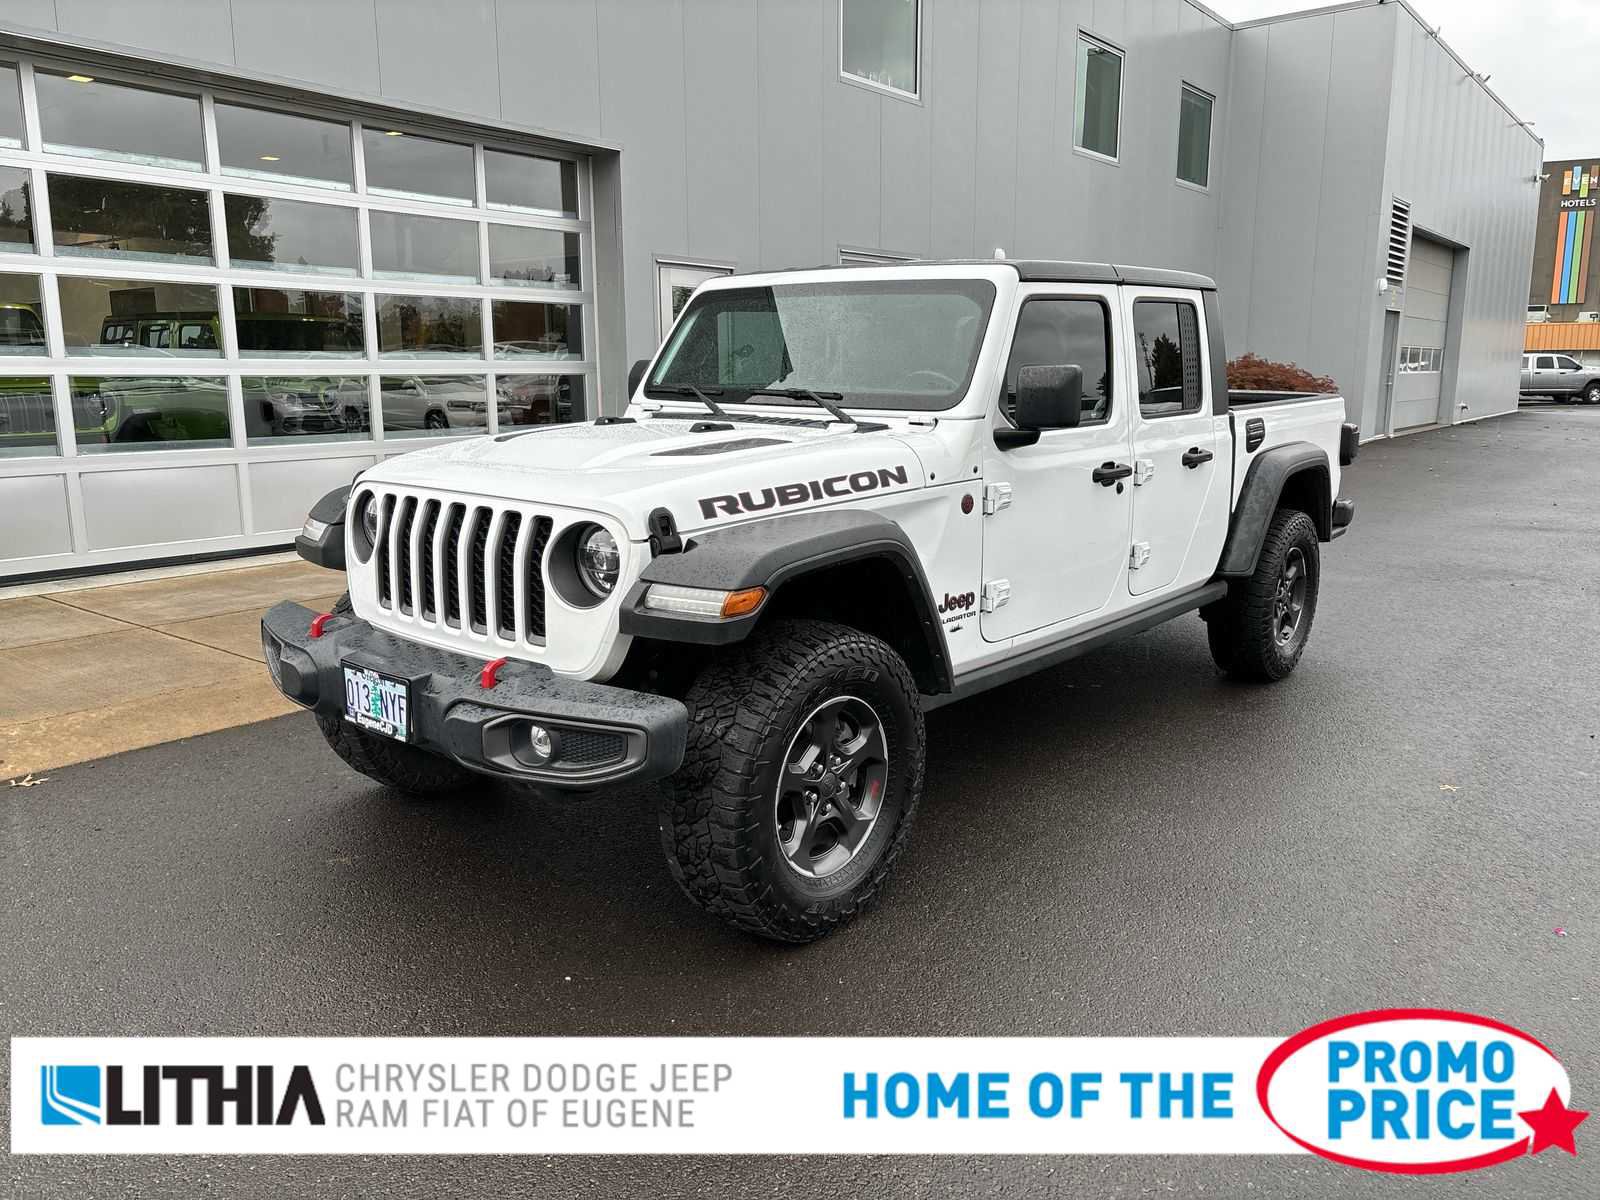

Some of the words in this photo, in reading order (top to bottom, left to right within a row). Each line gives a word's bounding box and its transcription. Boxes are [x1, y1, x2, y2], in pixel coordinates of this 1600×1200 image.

[1563, 175, 1598, 186] EVEN
[1560, 198, 1597, 208] HOTELS
[698, 465, 909, 521] RUBICON
[938, 591, 975, 613] Jeep
[942, 610, 977, 625] LADIATOR
[346, 678, 371, 713] 013
[380, 688, 406, 724] NYF
